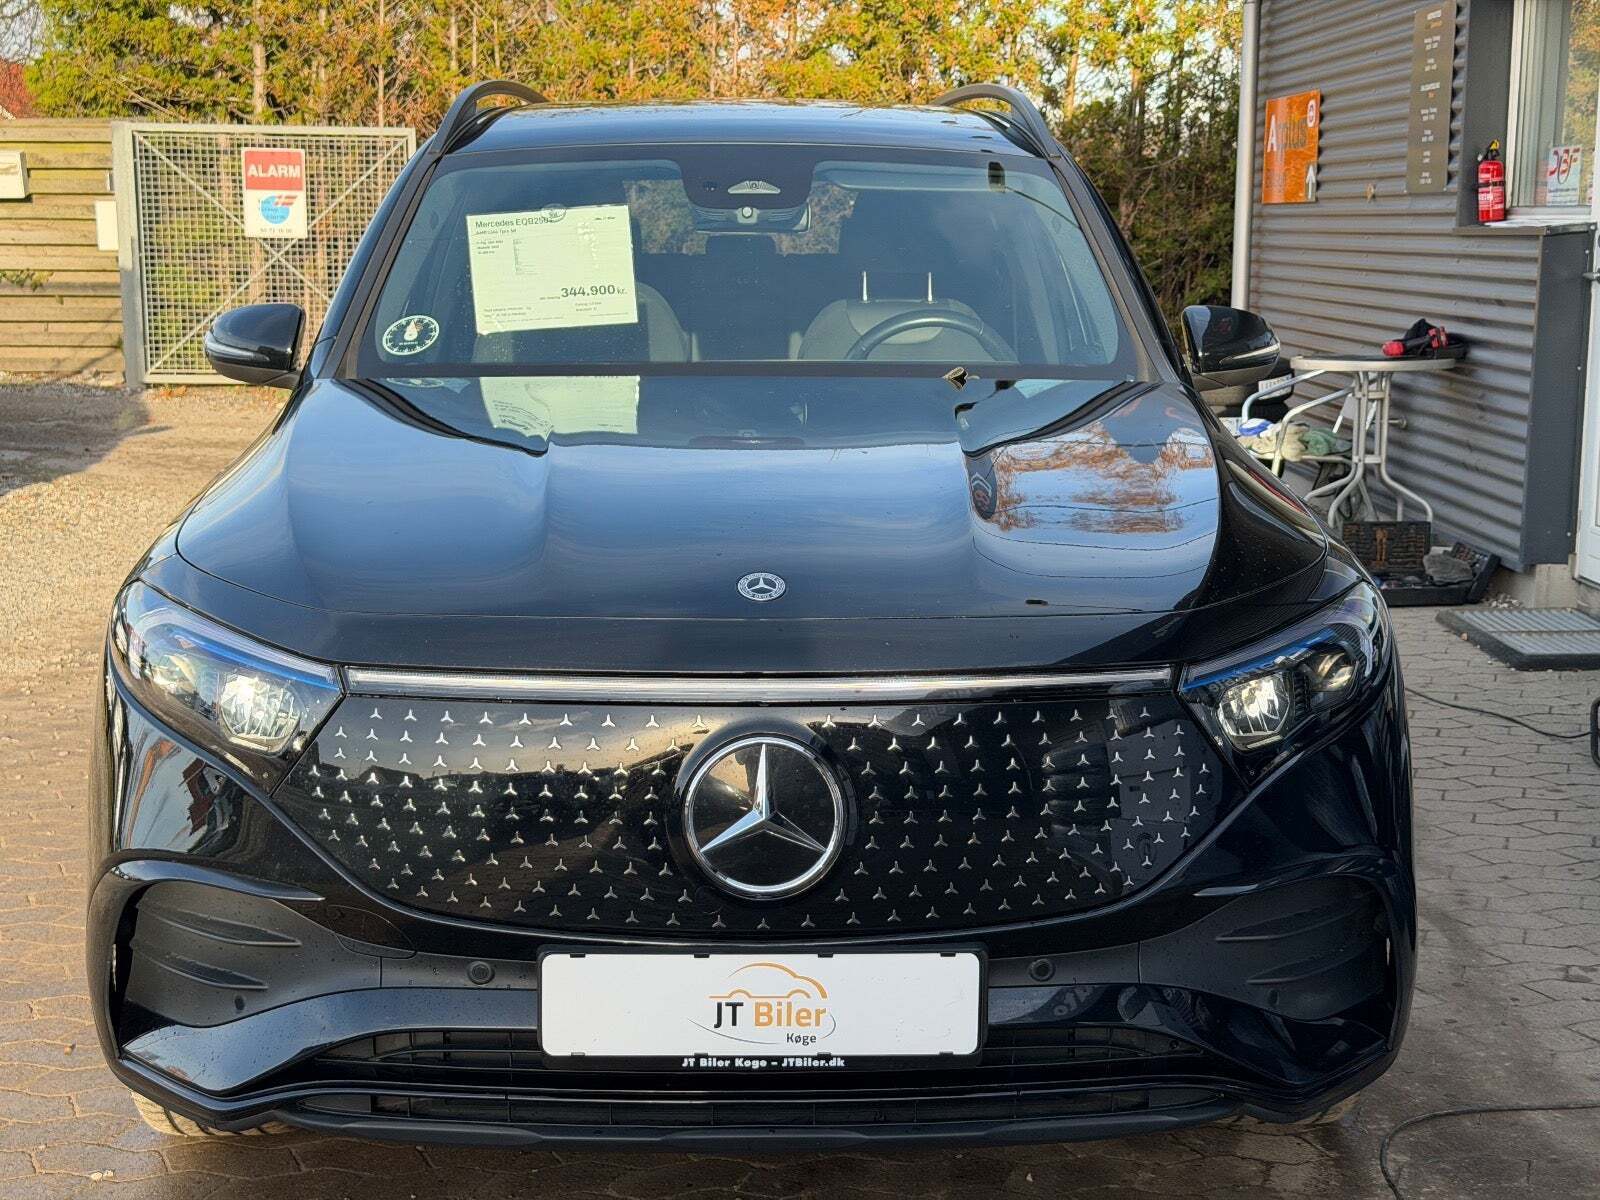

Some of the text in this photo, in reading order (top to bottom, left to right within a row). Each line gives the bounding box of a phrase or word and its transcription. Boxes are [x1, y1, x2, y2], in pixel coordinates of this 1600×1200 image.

[247, 164, 301, 178] ALARM
[475, 217, 514, 229] Mercedes
[561, 284, 616, 299] 344.900
[713, 1001, 827, 1029] JT Biler
[786, 1032, 817, 1046] Køge
[681, 1057, 696, 1068] JT
[699, 1057, 731, 1068] Biler
[781, 1057, 846, 1068] JTBiler.dk
